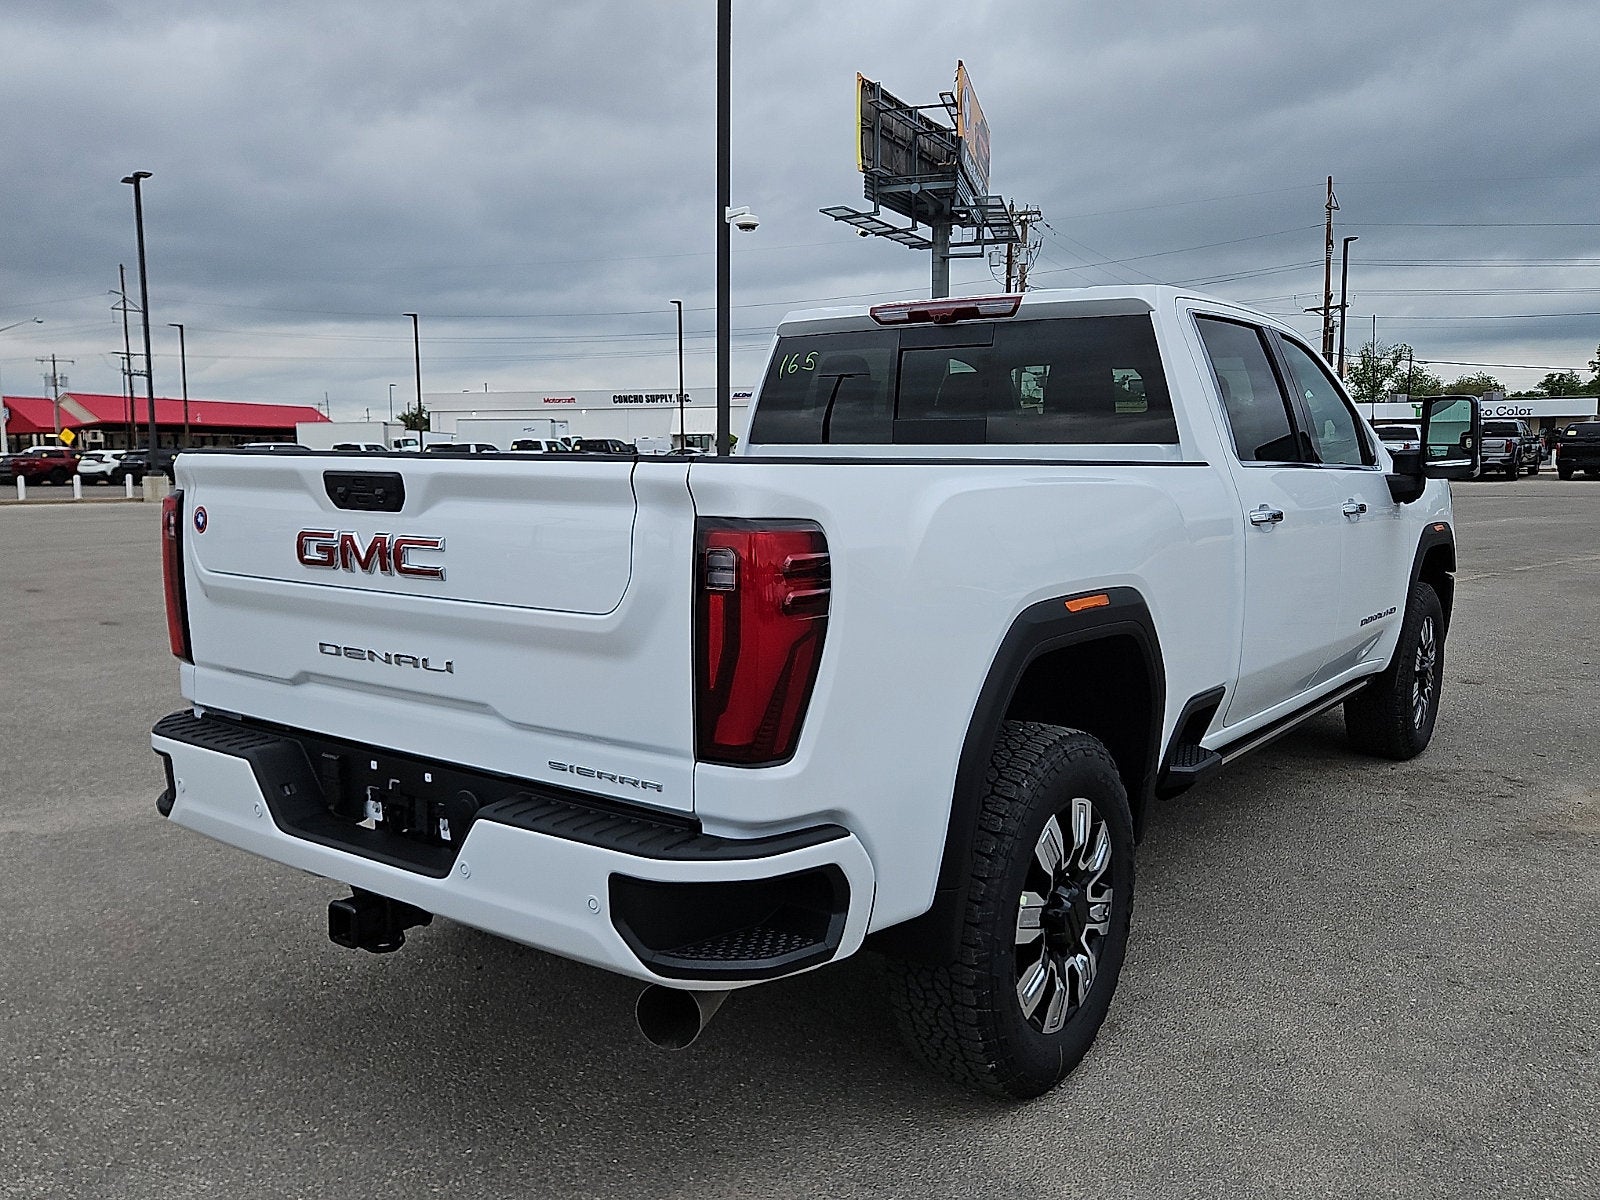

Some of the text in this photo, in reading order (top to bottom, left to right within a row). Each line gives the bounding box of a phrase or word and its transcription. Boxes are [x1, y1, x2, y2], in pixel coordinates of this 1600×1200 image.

[779, 351, 819, 380] 165
[612, 394, 644, 404] CONCHO
[1496, 405, 1534, 417] Color
[296, 528, 447, 582] GMC
[318, 641, 454, 674] DENALI
[548, 760, 664, 792] SIERRA
